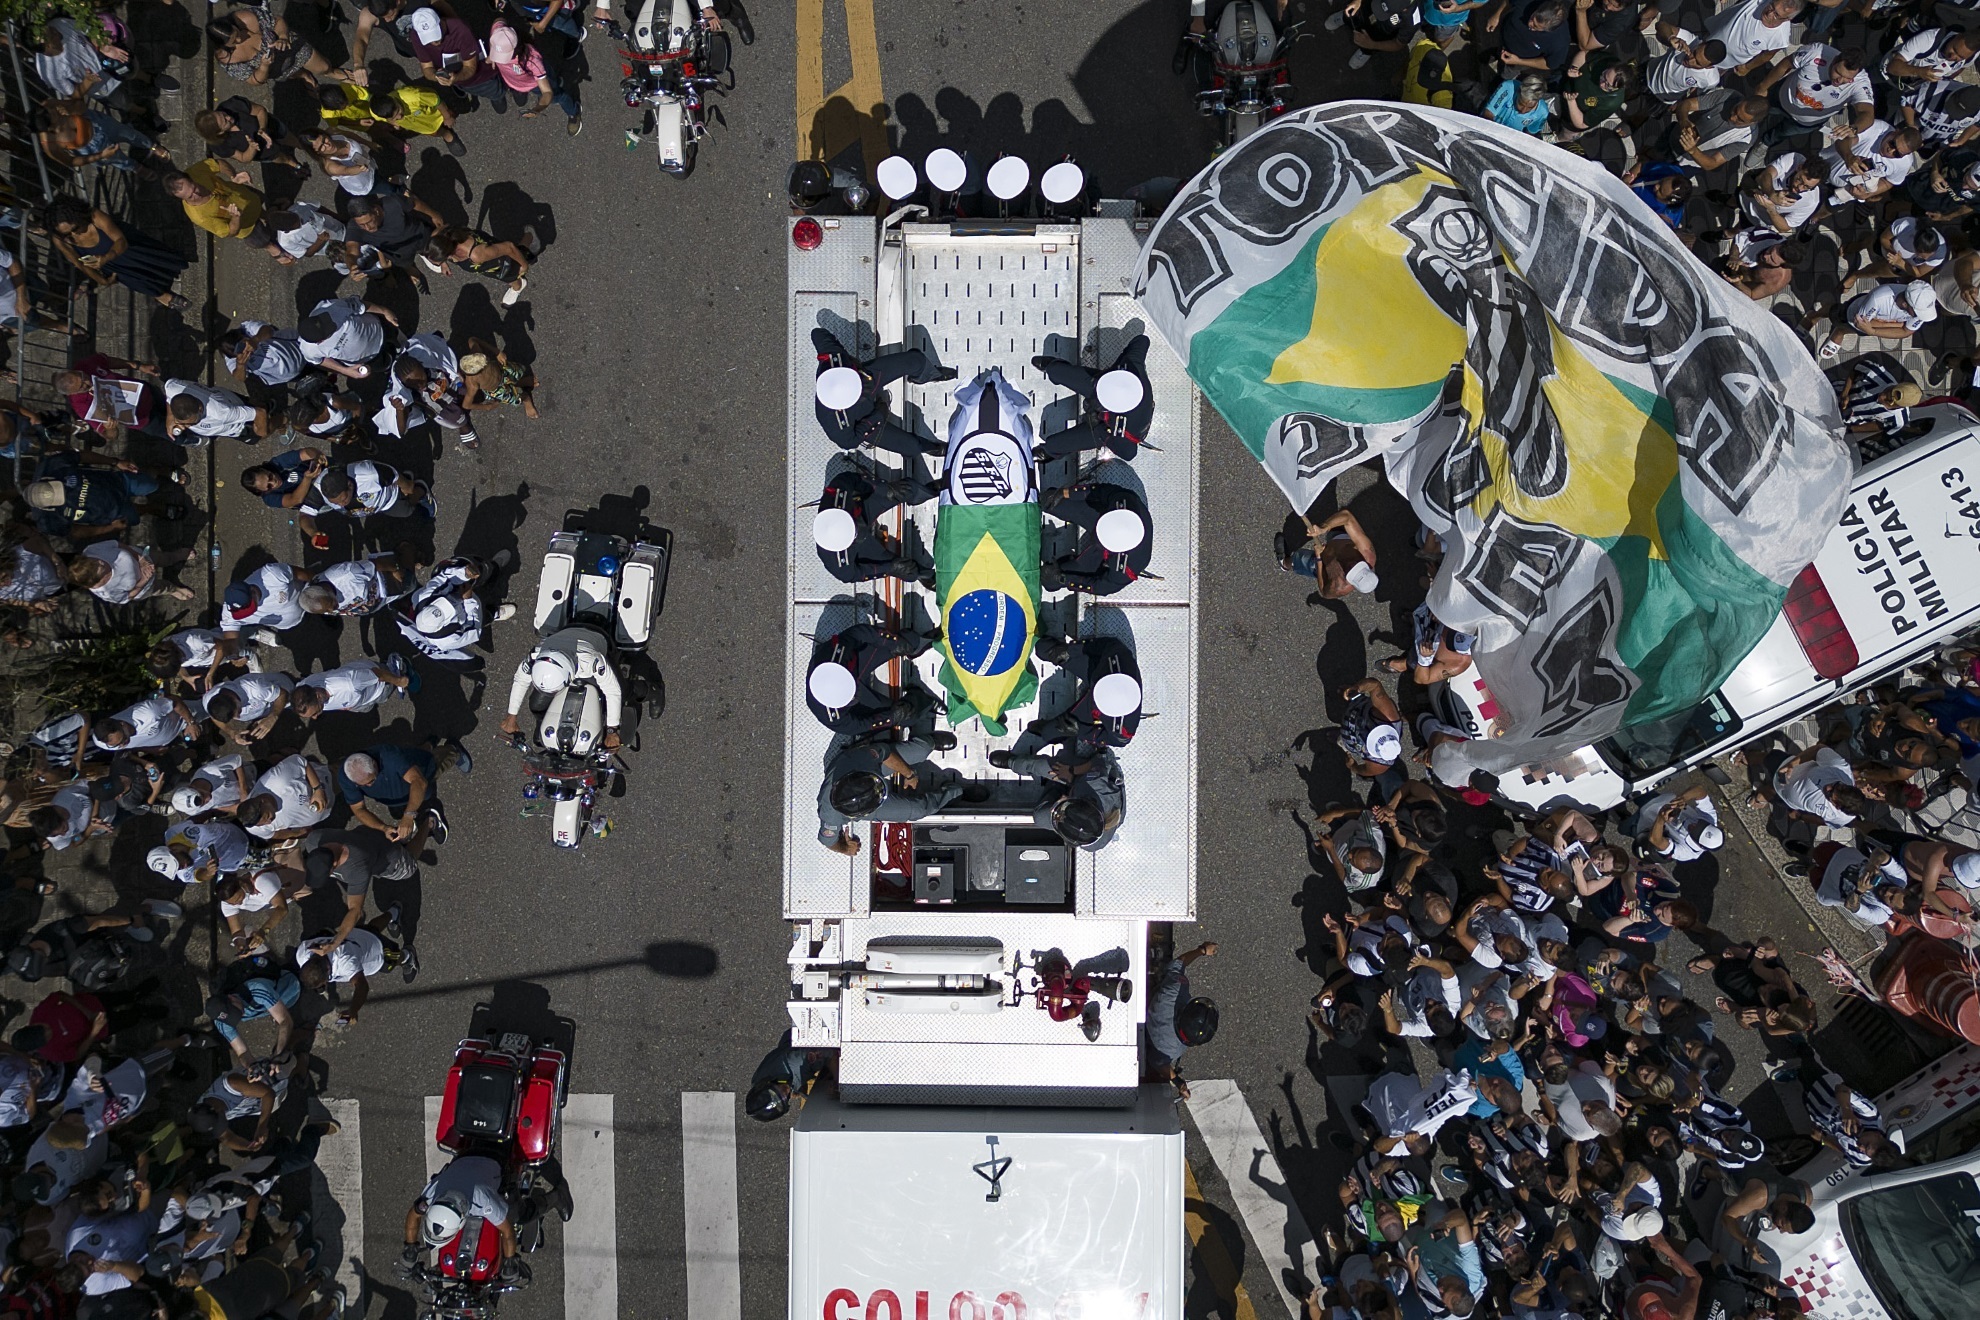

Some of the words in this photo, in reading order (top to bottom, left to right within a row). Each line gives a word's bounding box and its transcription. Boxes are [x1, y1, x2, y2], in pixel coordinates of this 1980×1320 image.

[665, 147, 675, 156] PE
[1839, 502, 1918, 636] POLÍCIA
[1867, 487, 1949, 622] MILITAR
[980, 631, 1001, 672] PROGRESSO
[557, 830, 569, 841] PE
[1826, 1167, 1850, 1187] 190
